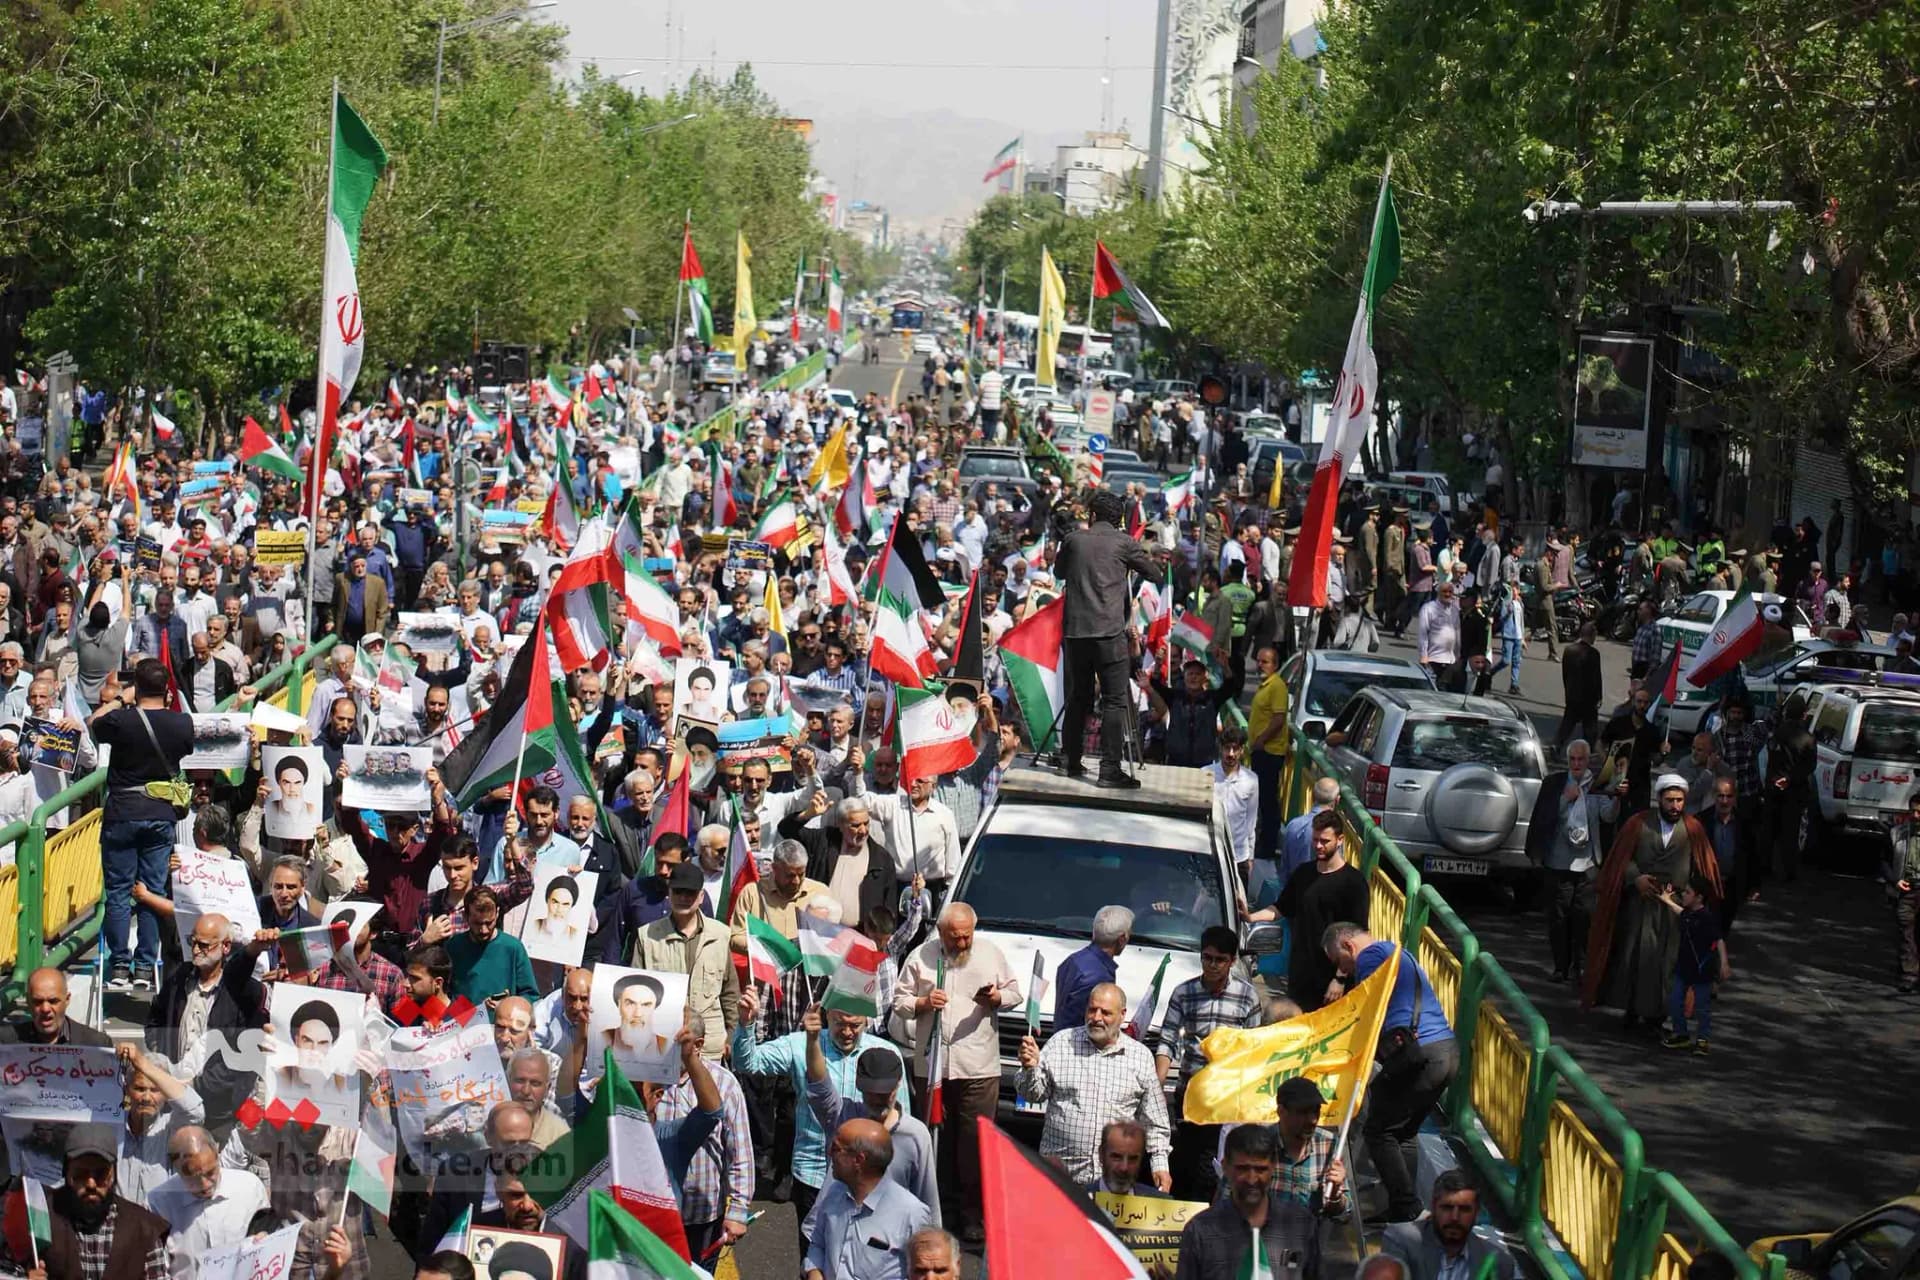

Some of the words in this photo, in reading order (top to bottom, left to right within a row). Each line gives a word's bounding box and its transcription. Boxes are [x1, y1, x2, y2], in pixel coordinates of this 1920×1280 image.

[1857, 767, 1910, 784] تهران
[218, 870, 246, 894] سپاه
[70, 1059, 114, 1087] سپاه
[1134, 1234, 1166, 1245] WITH
